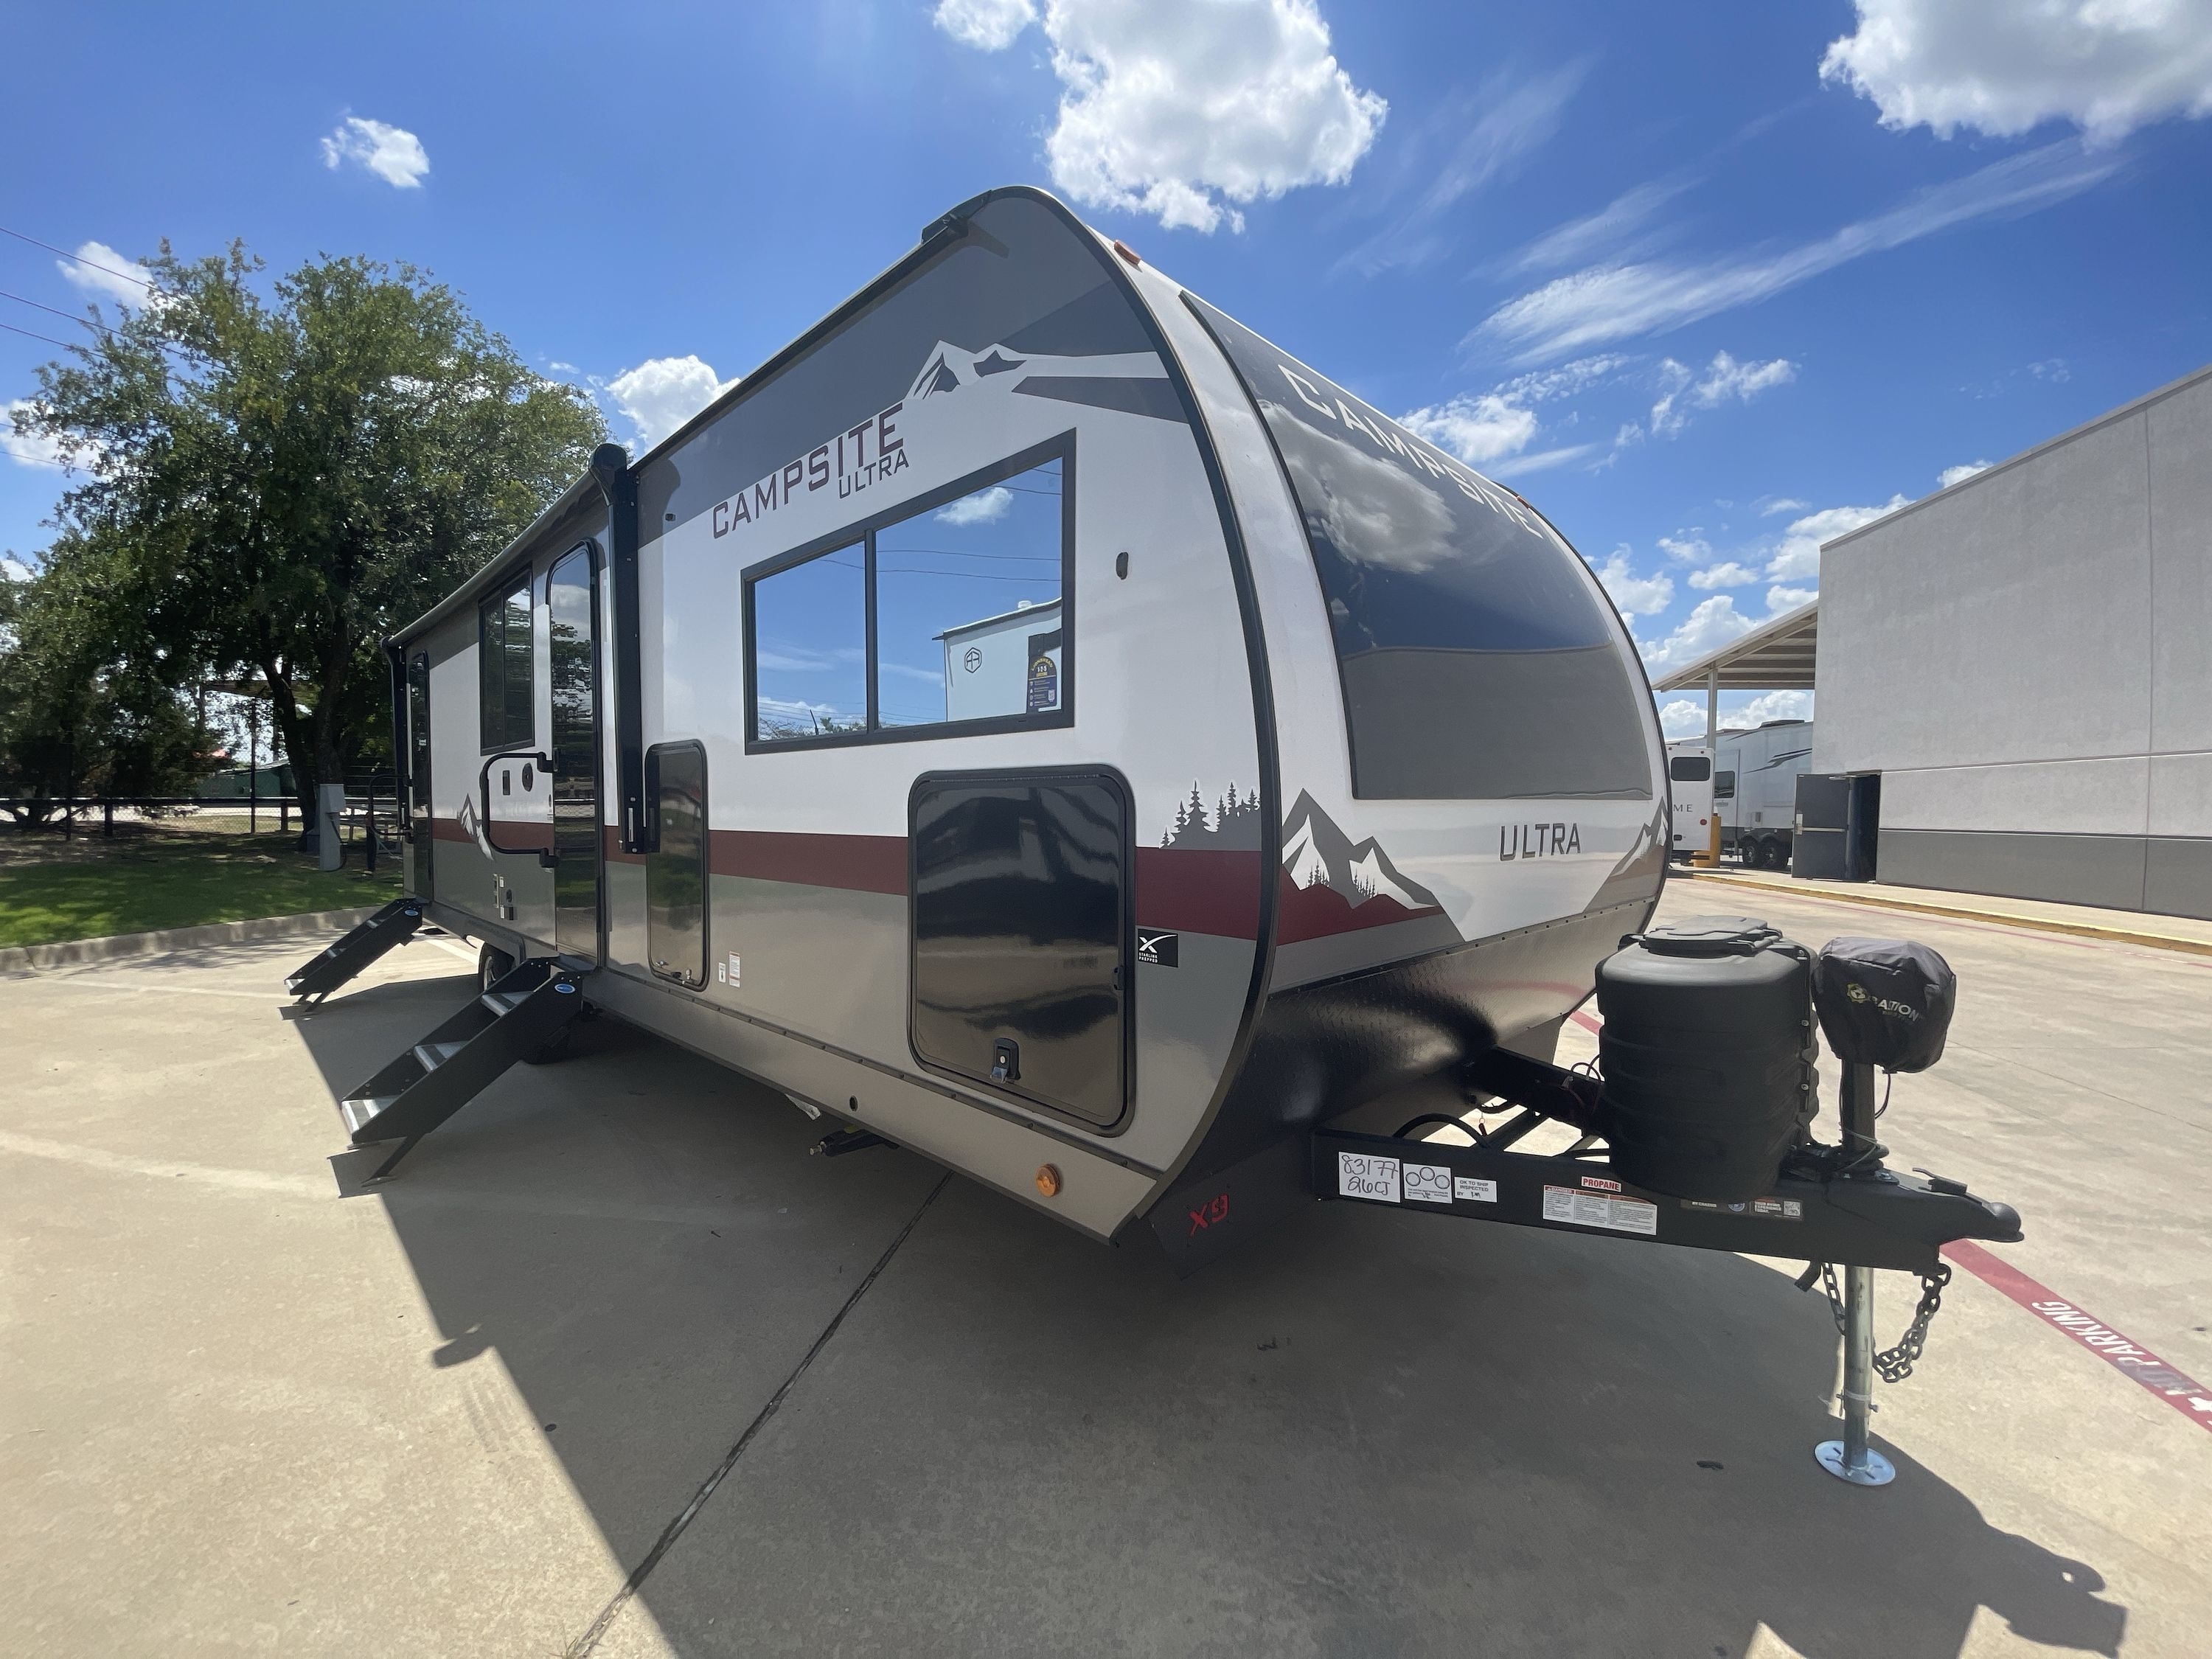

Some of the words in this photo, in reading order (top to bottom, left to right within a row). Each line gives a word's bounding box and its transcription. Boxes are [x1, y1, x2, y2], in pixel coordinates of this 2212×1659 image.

[713, 402, 903, 539] CAMPSITE
[839, 448, 909, 498] ULTRA
[1278, 364, 1543, 539] CAMPSITE
[1500, 823, 1581, 861] ULTRA
[1341, 1155, 1399, 1179] 83177
[1583, 1178, 1620, 1190] PROPANE
[2031, 1301, 2162, 1366] PARKING
